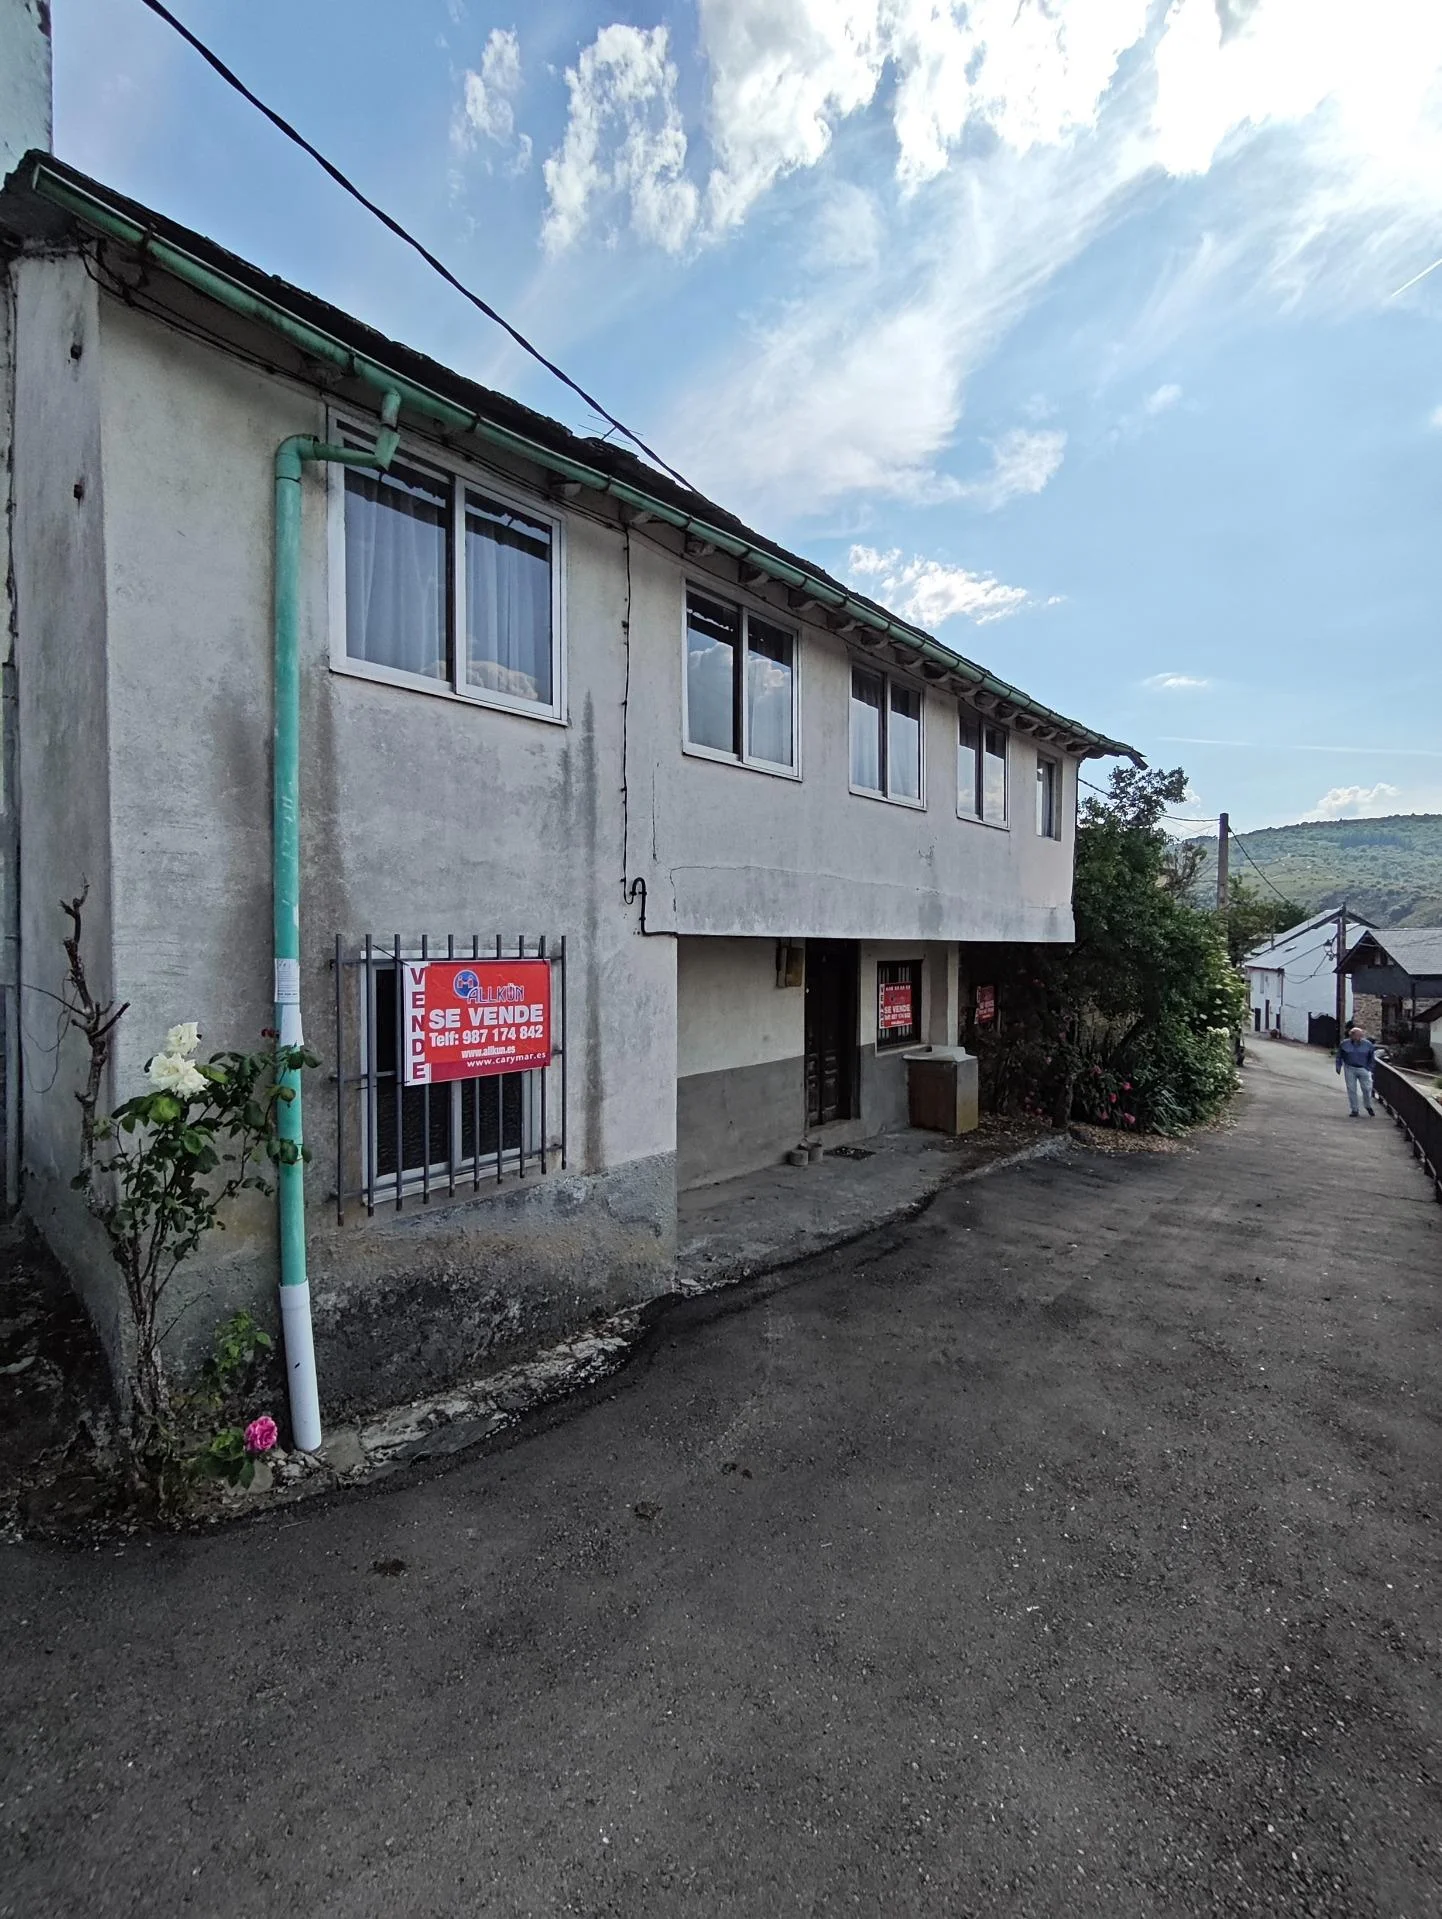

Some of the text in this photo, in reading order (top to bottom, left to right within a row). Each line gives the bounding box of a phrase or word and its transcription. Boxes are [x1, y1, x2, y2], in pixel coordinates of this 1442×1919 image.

[467, 983, 525, 1004] ALLKÜN
[410, 967, 426, 1079] VENDE
[428, 1004, 544, 1030] SE VENDE
[429, 1025, 544, 1048] Telf: 987 174 842
[461, 1045, 516, 1059] www.allkun.es
[467, 1052, 546, 1067] www.carymar.es
